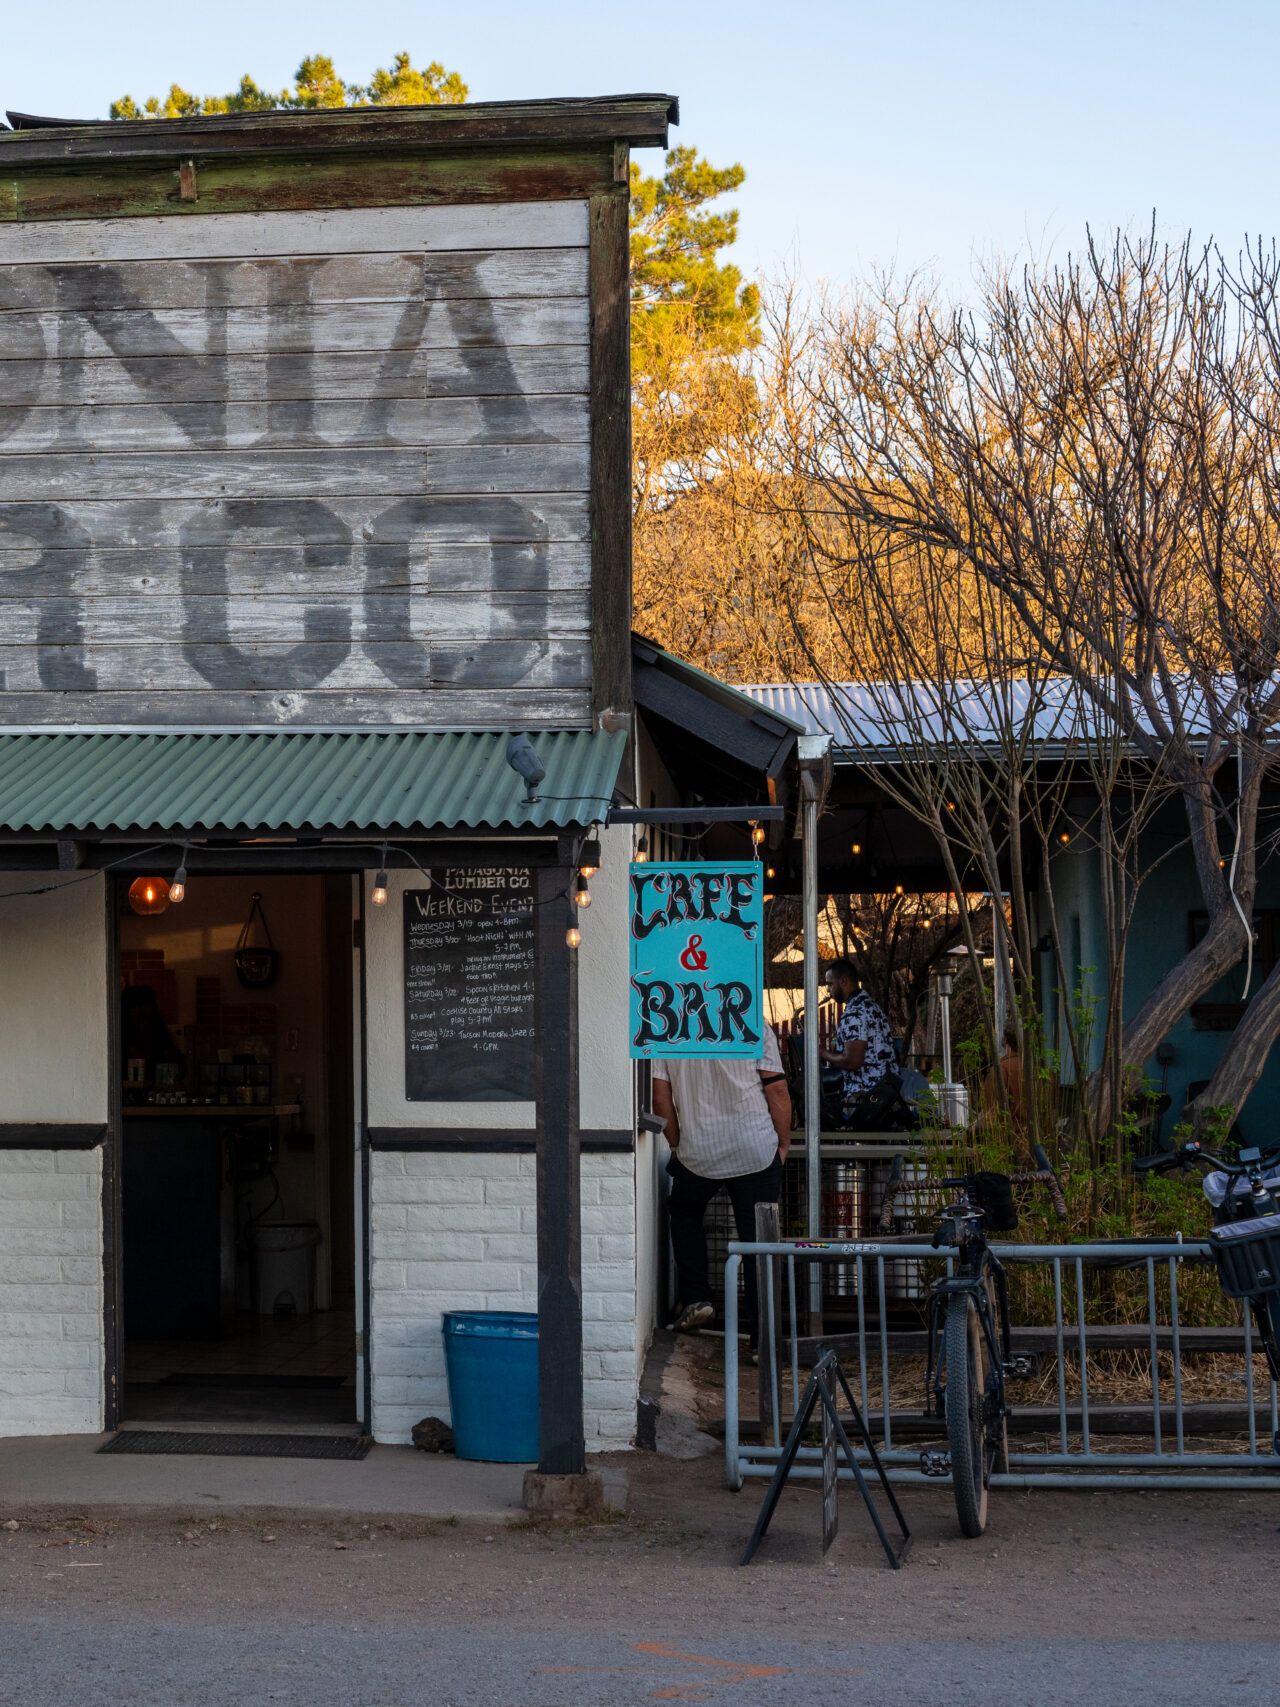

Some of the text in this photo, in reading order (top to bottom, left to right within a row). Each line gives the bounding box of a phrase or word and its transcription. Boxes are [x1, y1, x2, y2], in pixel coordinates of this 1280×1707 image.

[445, 877, 505, 889] LUMBER
[446, 868, 530, 876] PATAGONIA
[416, 895, 483, 917] WEEKEND
[630, 872, 759, 940] CAFE
[679, 934, 709, 971] &
[631, 972, 760, 1047] BAR
